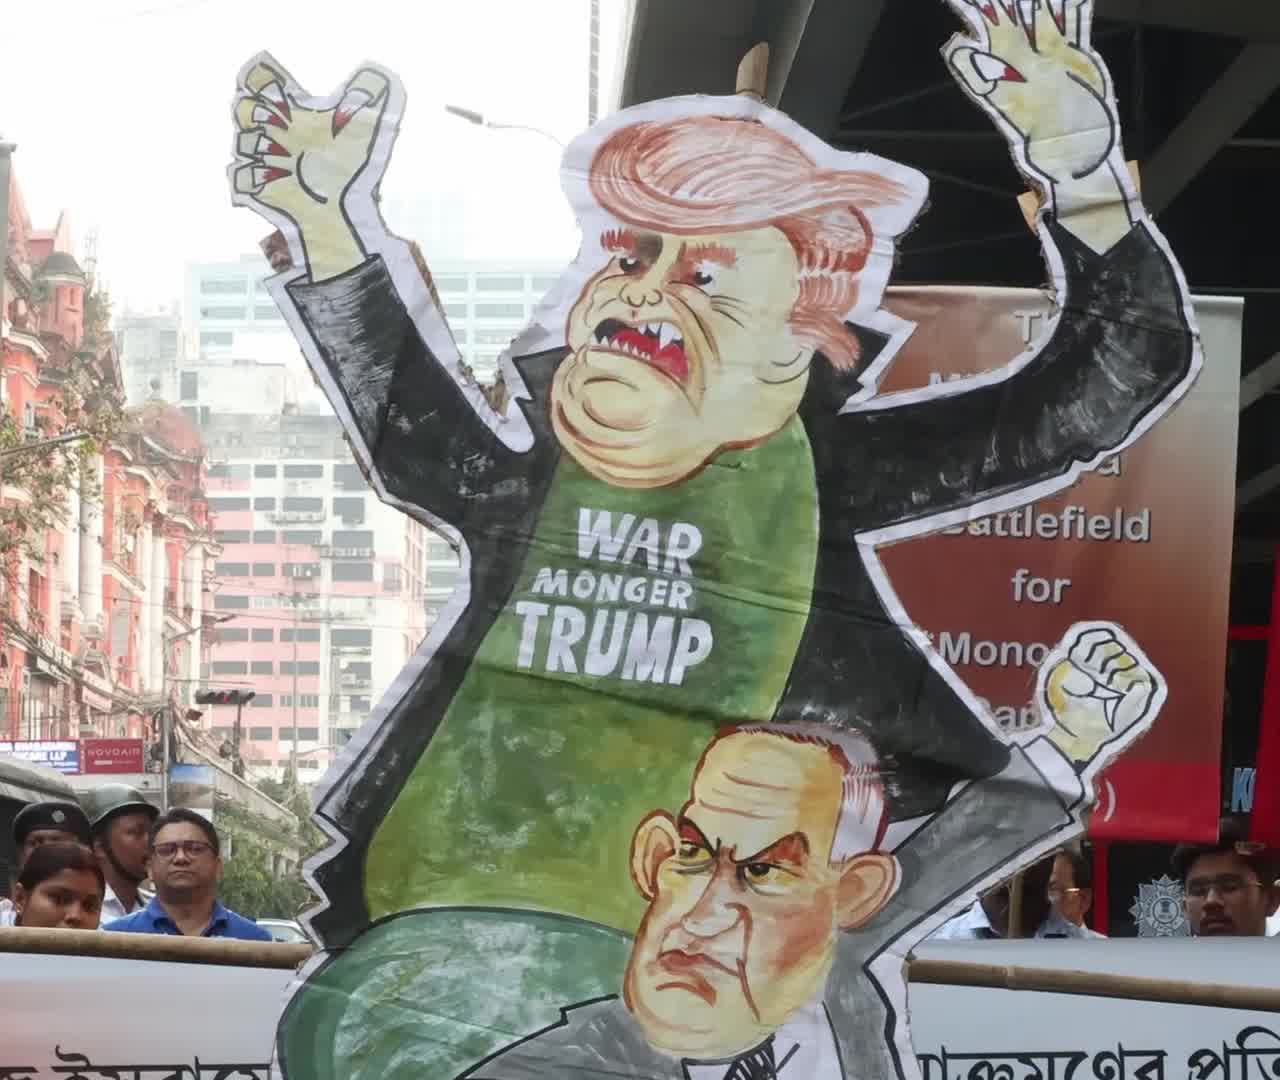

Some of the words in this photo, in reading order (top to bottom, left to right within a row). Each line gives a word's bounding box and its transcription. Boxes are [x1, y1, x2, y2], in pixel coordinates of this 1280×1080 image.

[576, 507, 703, 577] WAR
[942, 504, 1152, 543] attlefield
[531, 567, 694, 610] MONGER
[1011, 569, 1072, 604] for
[515, 600, 713, 685] TRUMP
[930, 631, 1056, 668] Mono
